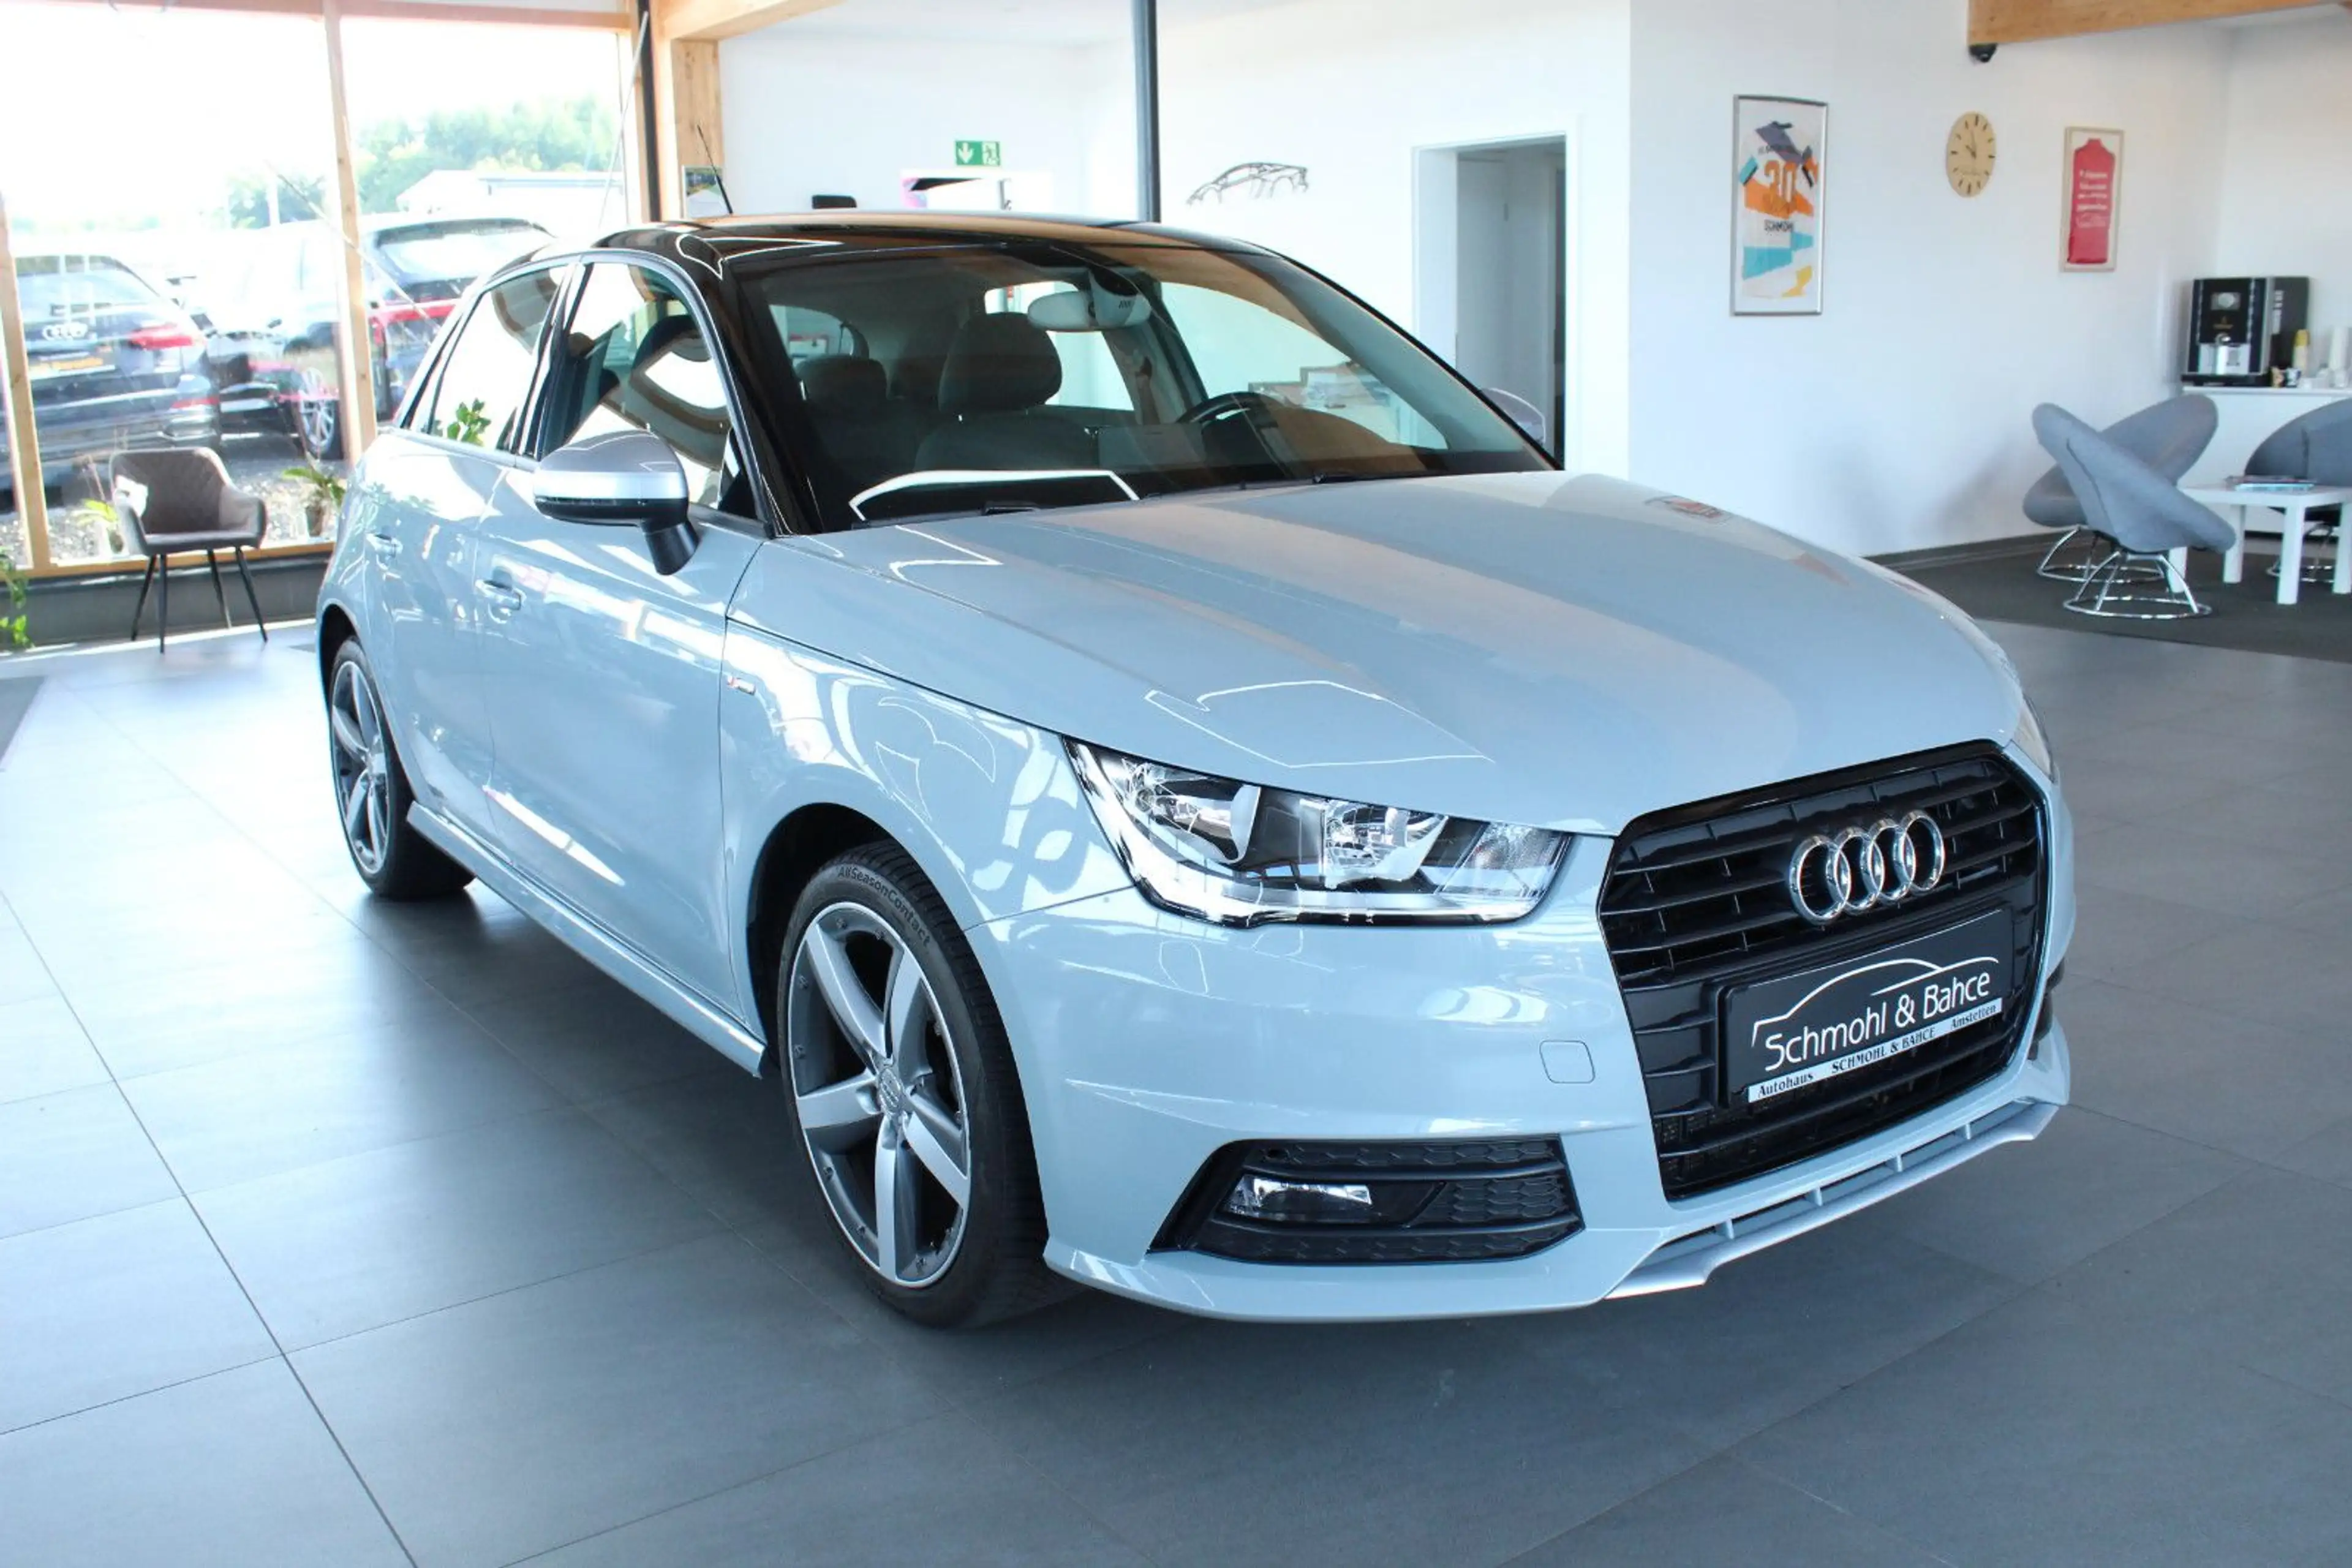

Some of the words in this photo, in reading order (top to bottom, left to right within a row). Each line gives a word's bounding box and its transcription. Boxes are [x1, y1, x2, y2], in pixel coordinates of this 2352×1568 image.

[1765, 1001, 1887, 1071] Schmohl
[1894, 993, 1916, 1028] &
[1923, 972, 1991, 1019] Bahce
[1758, 1072, 1814, 1098] Autohaus
[1831, 1046, 1885, 1074] SCHMOHL
[1890, 1043, 1898, 1054] &
